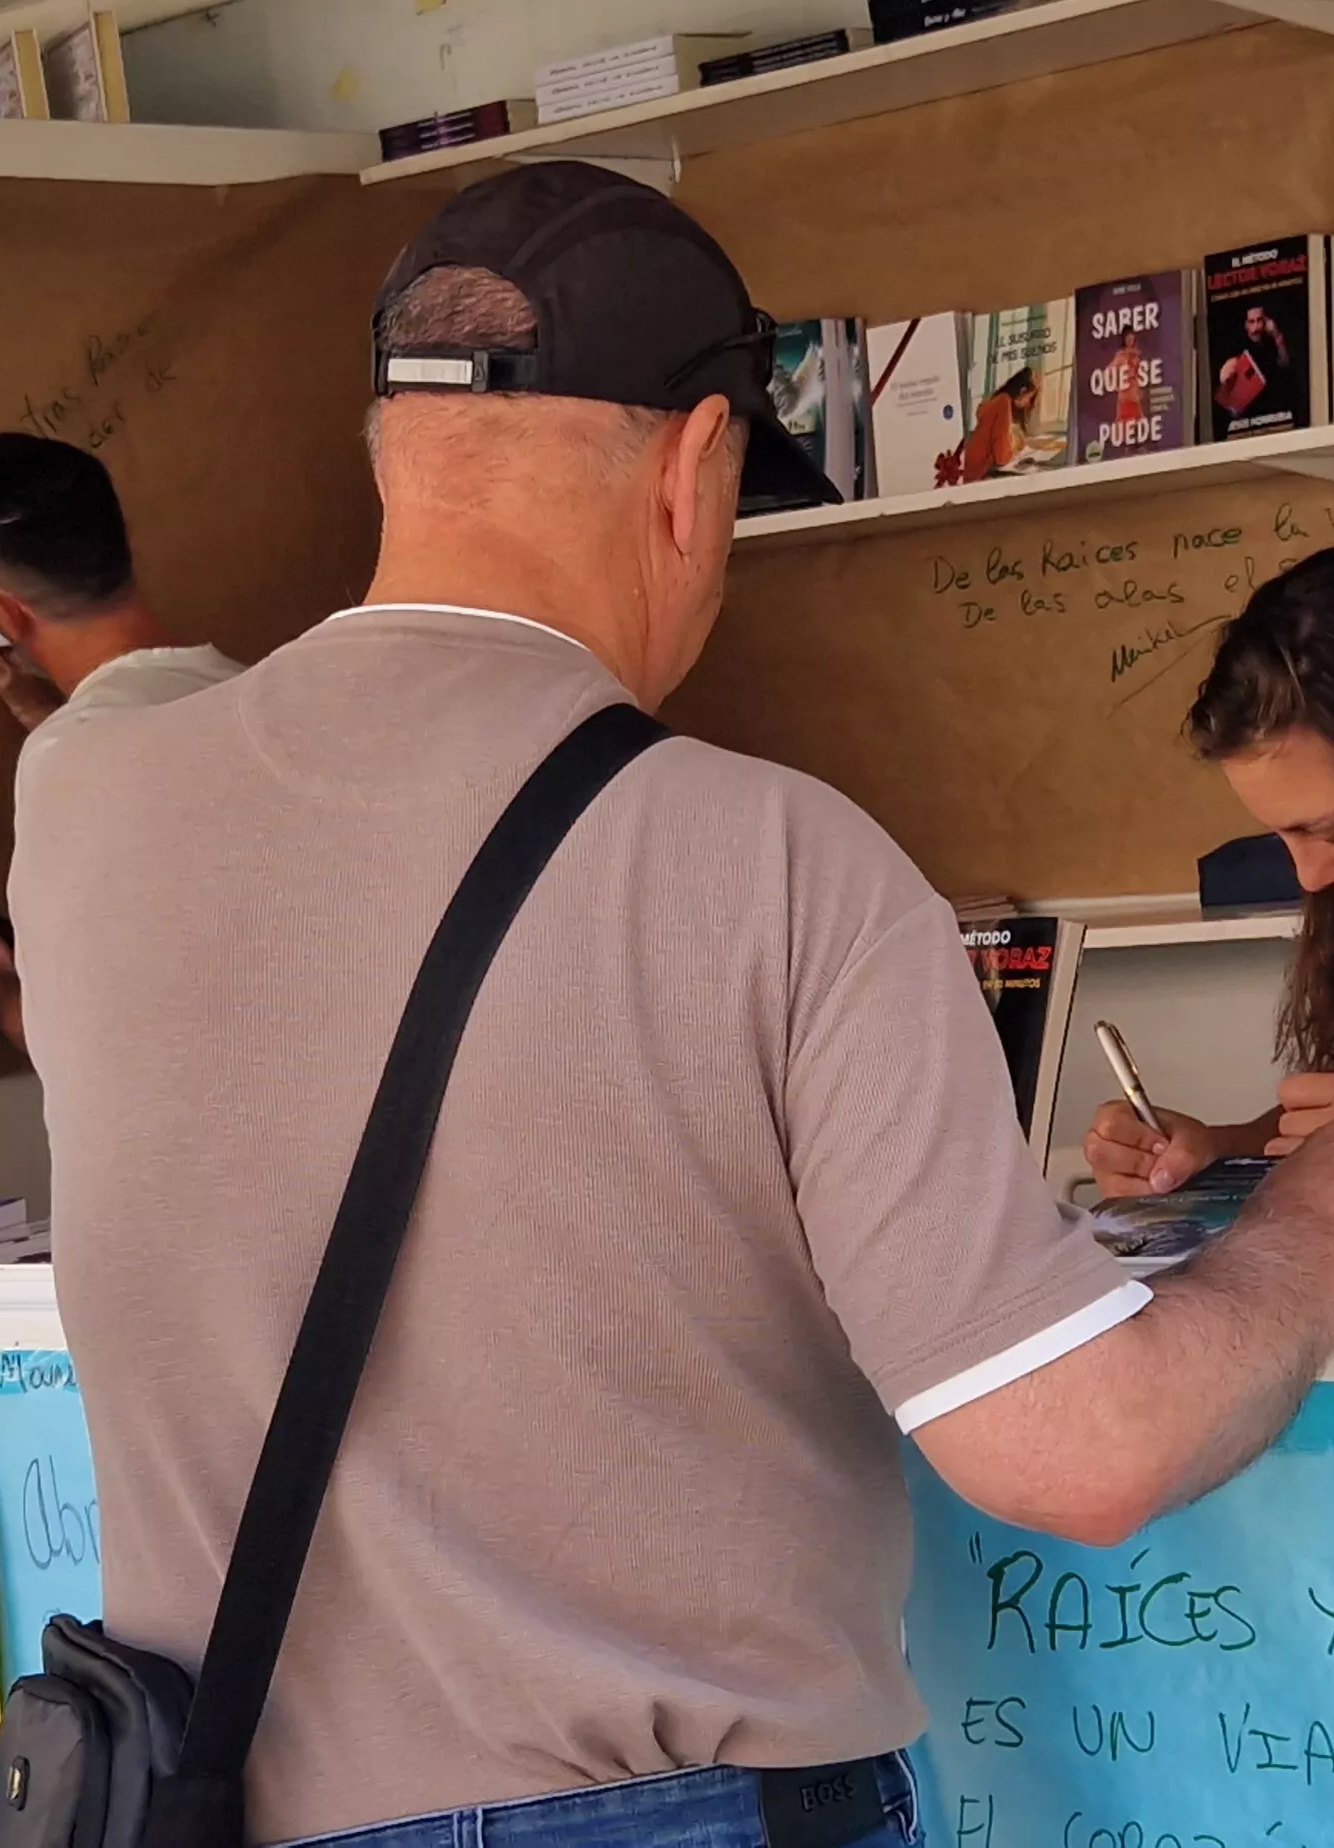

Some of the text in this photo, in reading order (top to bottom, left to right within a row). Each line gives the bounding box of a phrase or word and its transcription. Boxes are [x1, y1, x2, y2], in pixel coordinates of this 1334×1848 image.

[1091, 301, 1160, 340] SABER
[1090, 357, 1163, 397] QUE SE
[1099, 415, 1163, 448] PUEDE
[933, 555, 971, 595] De
[1173, 525, 1244, 560] nace
[1273, 502, 1310, 542] la
[962, 601, 996, 630] De
[1020, 588, 1067, 616] las
[1094, 582, 1185, 612] alas
[961, 1696, 1026, 1747] ES
[1071, 1703, 1155, 1756] UN
[800, 1773, 856, 1812] BOSS
